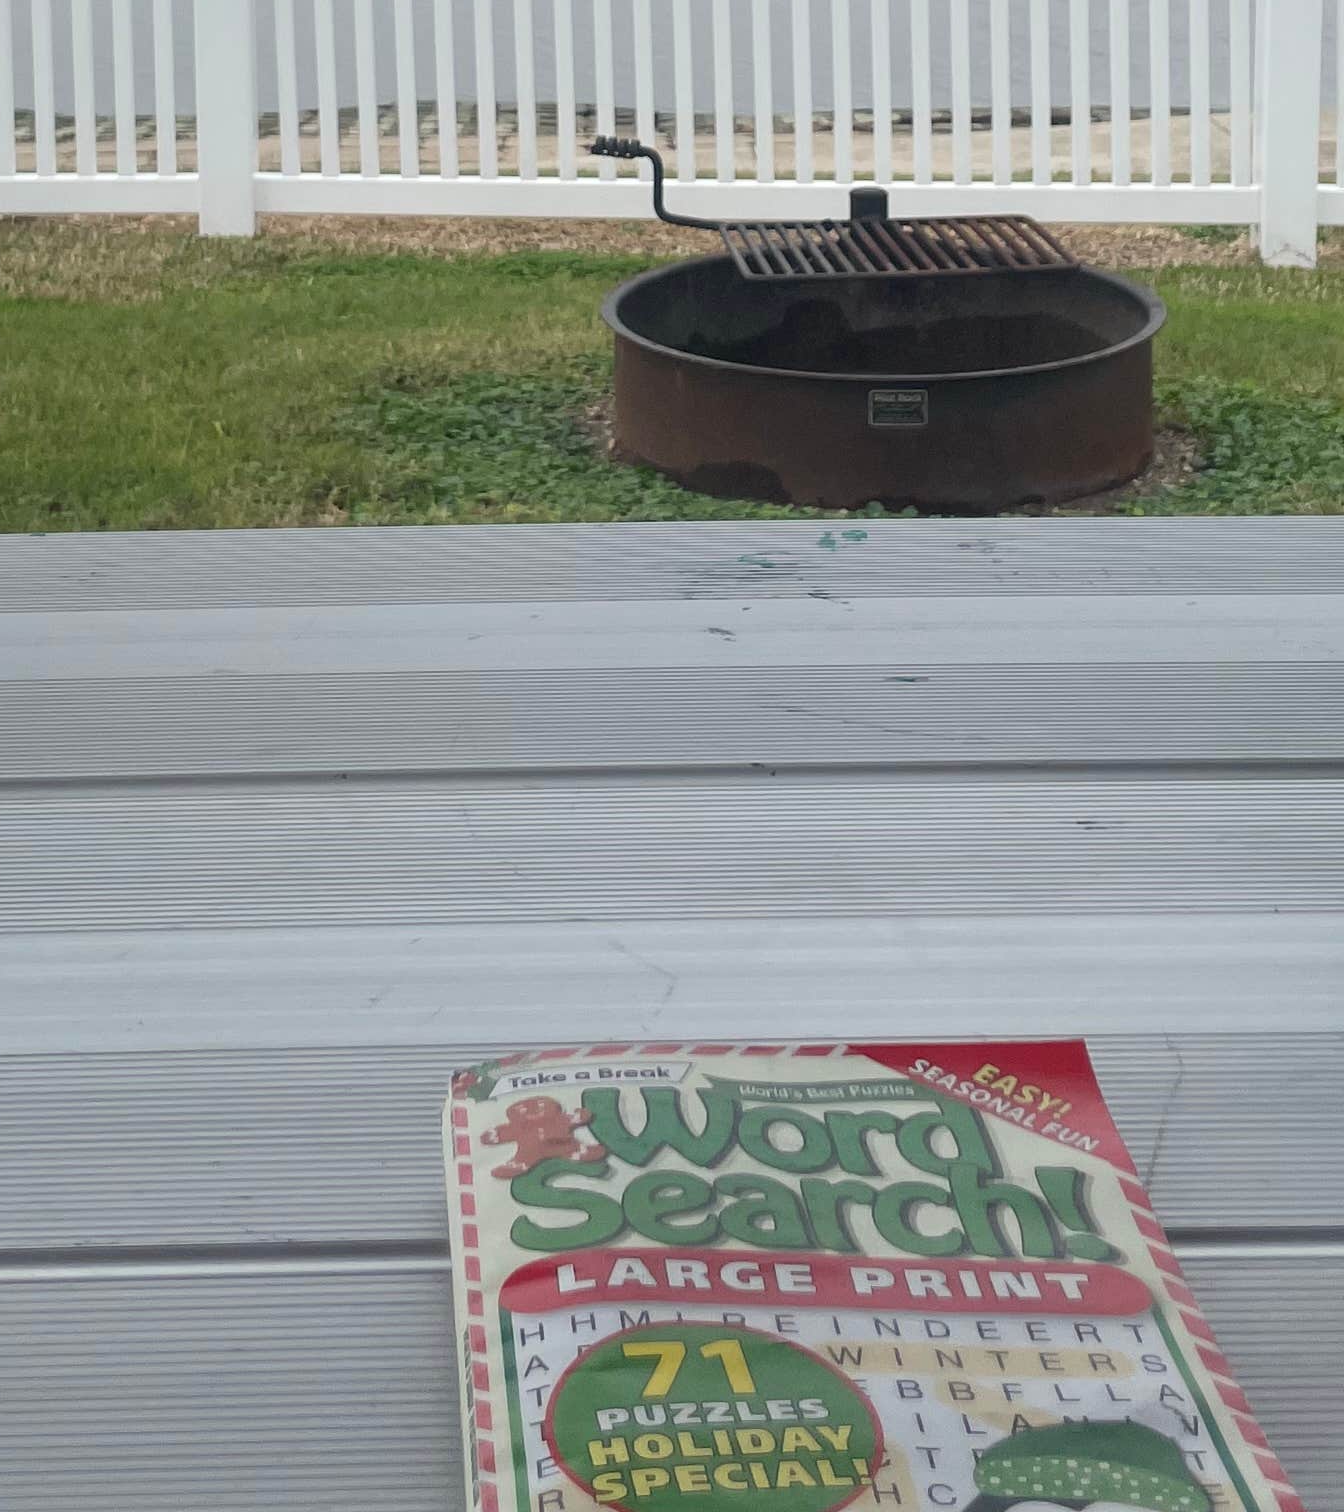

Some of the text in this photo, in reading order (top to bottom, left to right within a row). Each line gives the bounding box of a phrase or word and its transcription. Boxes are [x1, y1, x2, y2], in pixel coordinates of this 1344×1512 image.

[509, 1066, 671, 1088] Take a Break
[739, 1084, 915, 1099] World's Best Puzzles
[972, 1064, 1072, 1120] EASY!
[908, 1059, 1100, 1152] SEASONAL FUN
[581, 1086, 998, 1176] Word
[510, 1157, 1116, 1262] Search!
[557, 1256, 1090, 1303] LARGE PRINT
[622, 1339, 756, 1398] 71
[596, 1398, 830, 1431] PUZZLES
[588, 1424, 853, 1467] HOLIDAY
[592, 1457, 874, 1505] SPECIAL!
